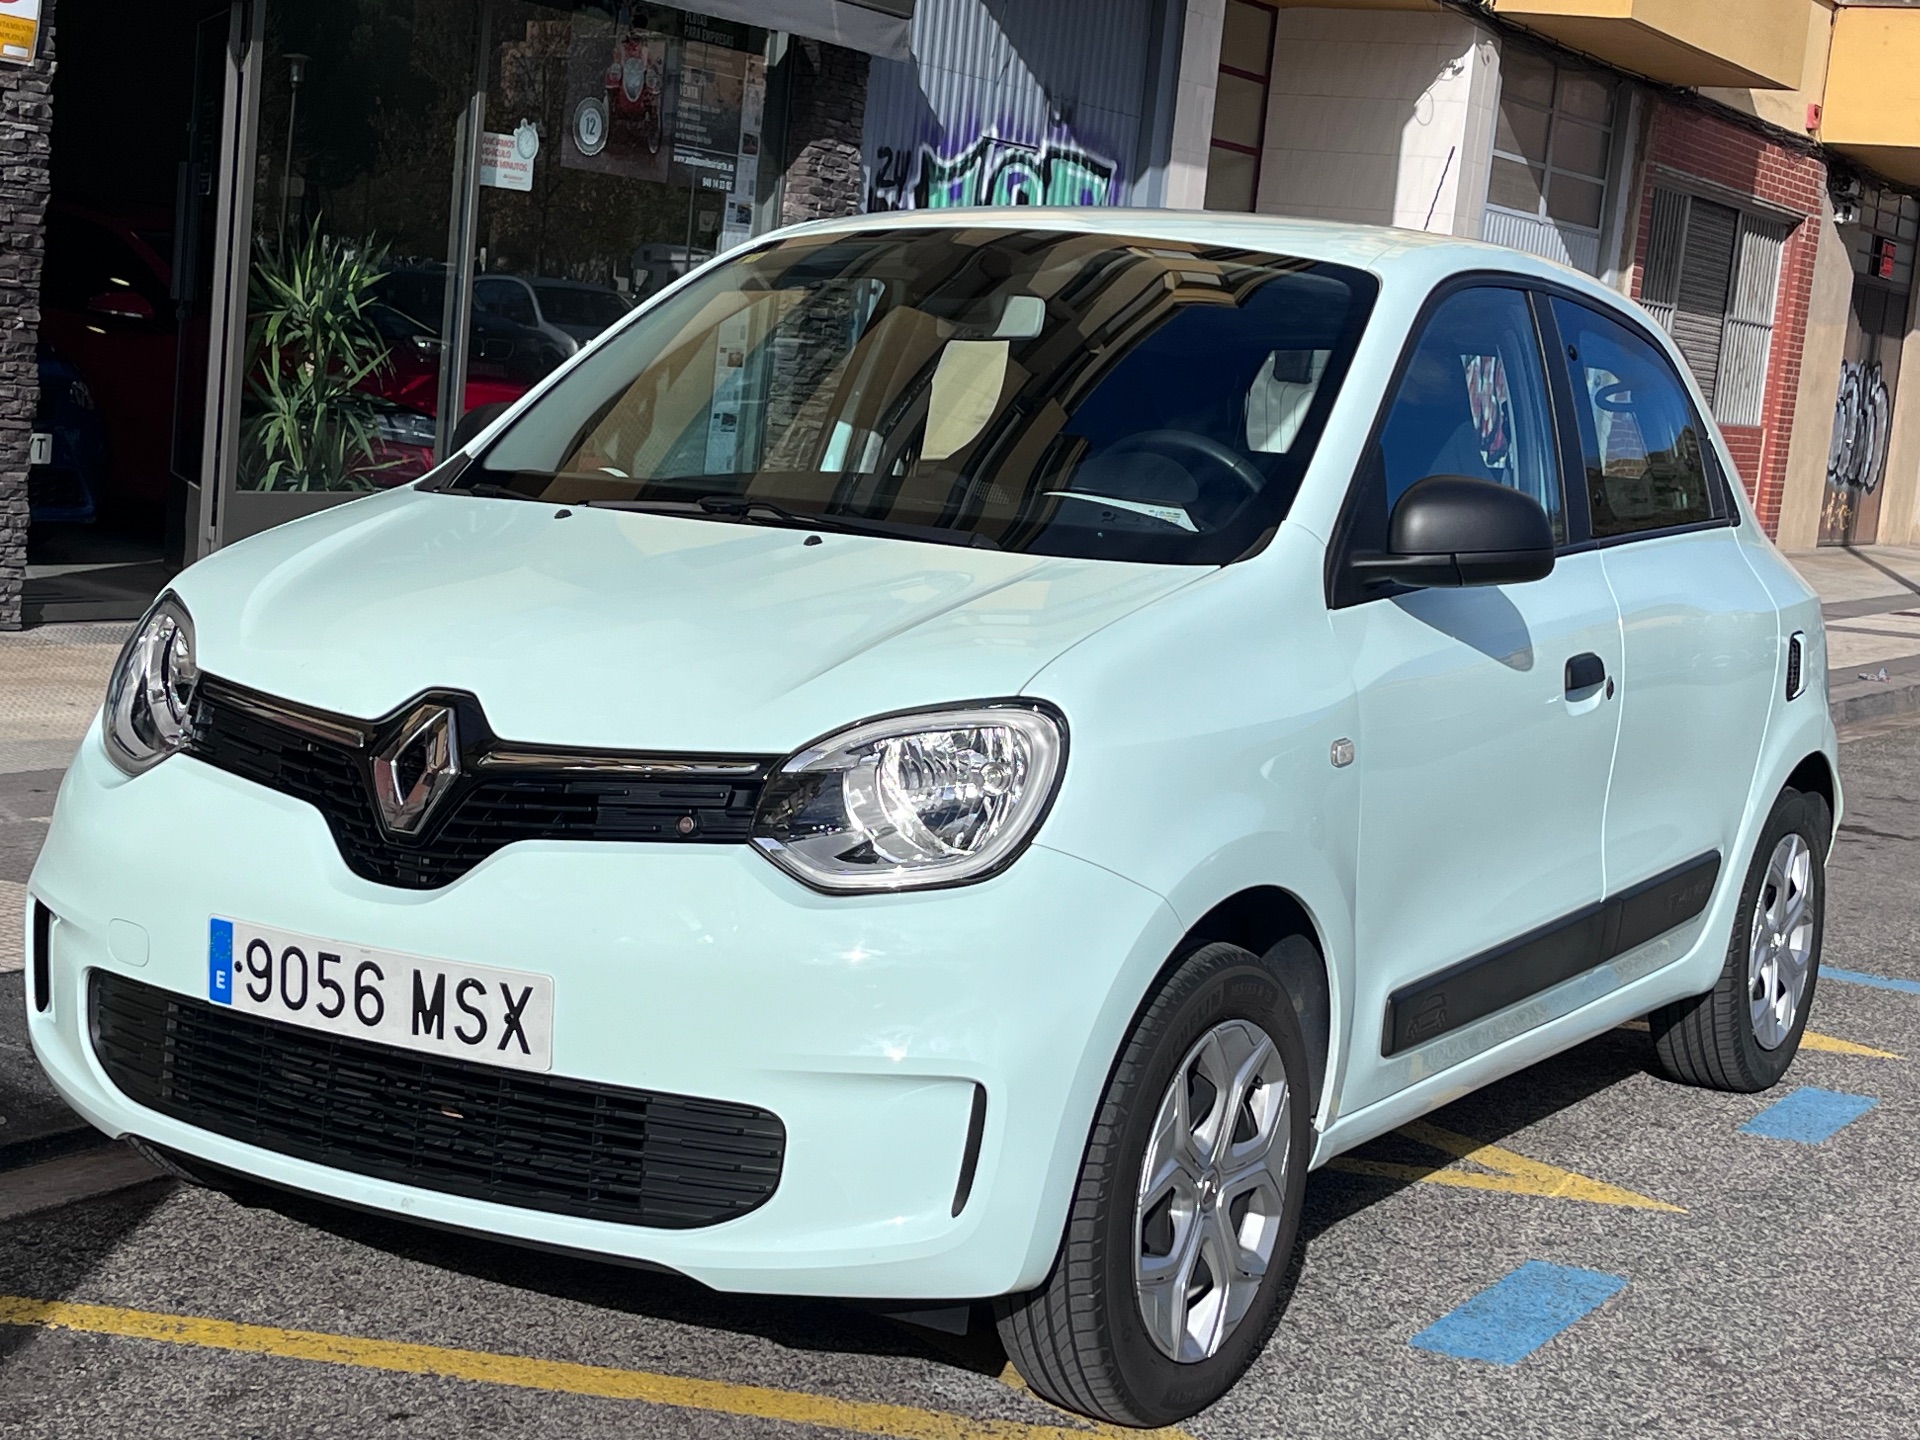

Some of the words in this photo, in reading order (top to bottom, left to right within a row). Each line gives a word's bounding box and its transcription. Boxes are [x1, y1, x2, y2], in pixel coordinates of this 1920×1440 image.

[585, 117, 597, 136] 12
[215, 970, 226, 989] E
[246, 938, 385, 1027] 9056
[412, 968, 534, 1055] MSX
